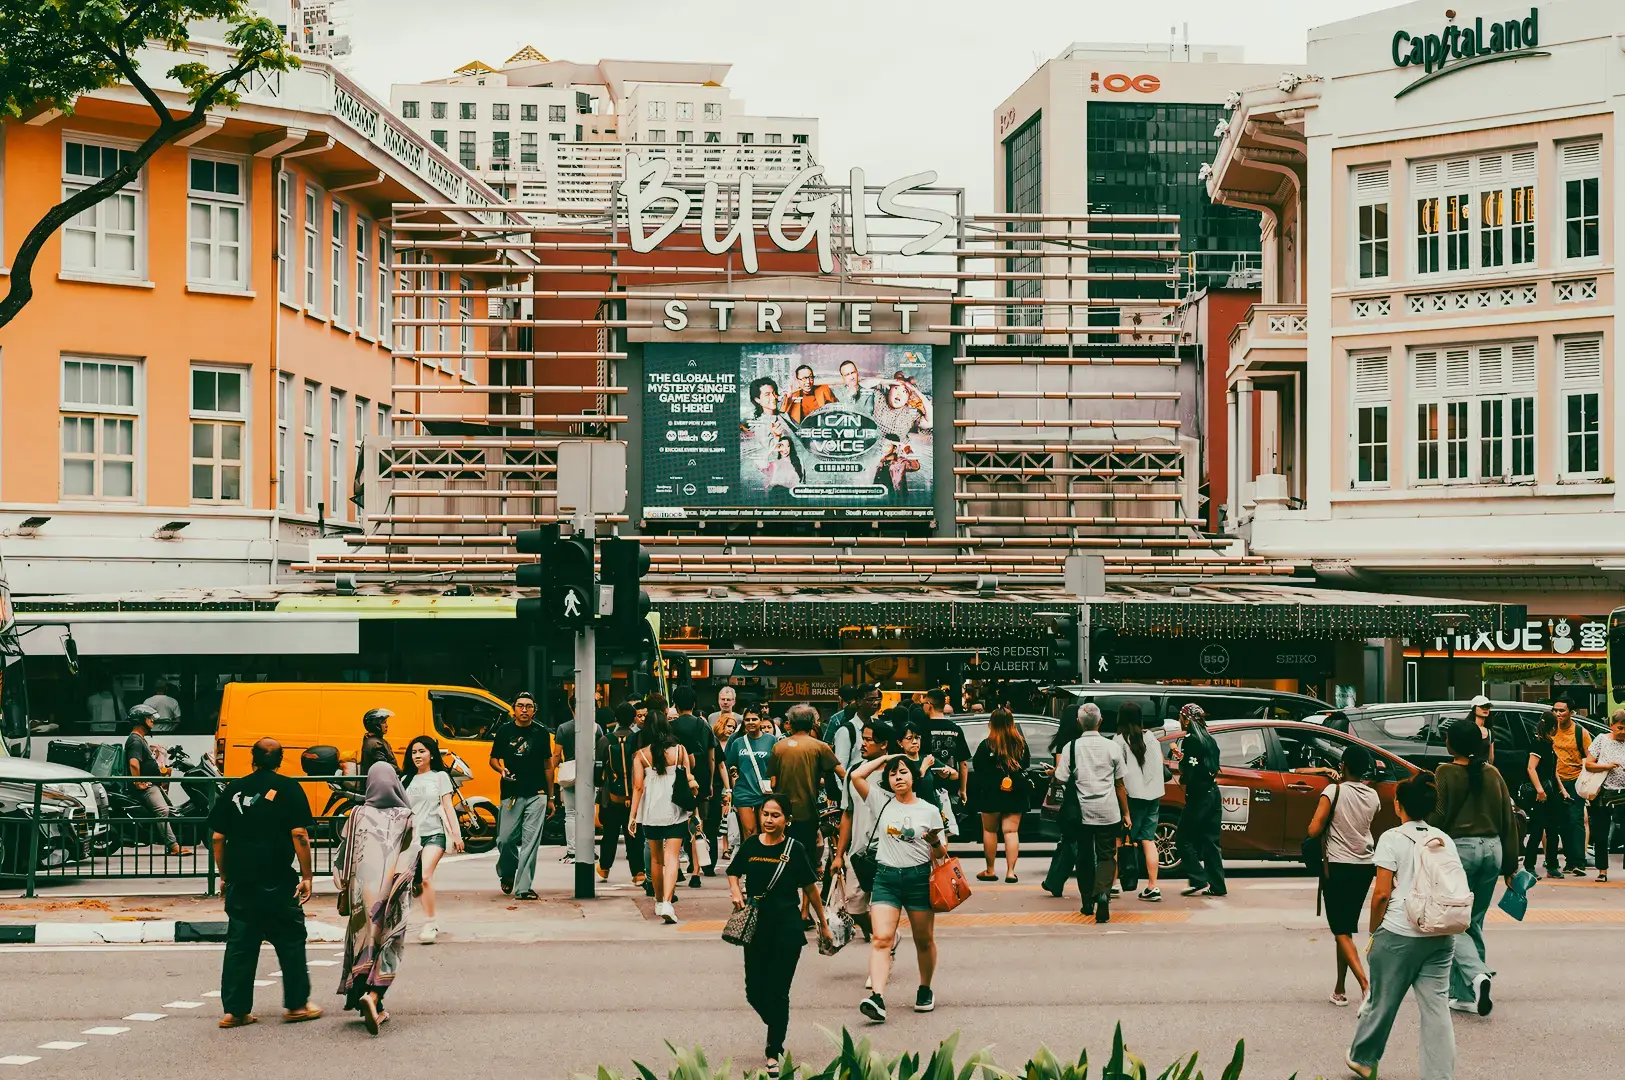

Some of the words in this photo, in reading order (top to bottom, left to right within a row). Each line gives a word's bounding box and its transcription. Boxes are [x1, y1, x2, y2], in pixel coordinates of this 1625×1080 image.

[1392, 7, 1538, 74] CapitaLand
[1103, 74, 1160, 93] OG
[618, 152, 955, 274] BUGIS
[663, 300, 919, 334] STREET
[649, 374, 671, 383] THE
[672, 374, 715, 383] GLOBAL
[716, 374, 735, 383] HIT
[647, 384, 695, 393] MYSTERY
[697, 384, 736, 393] SINGER
[659, 394, 690, 403] GAME
[691, 394, 725, 403] SHOW
[670, 404, 681, 413] IS
[682, 404, 714, 413] HERE!
[817, 415, 821, 427] I
[825, 415, 861, 427] CAN
[800, 428, 832, 439] SEE
[833, 428, 876, 439] YOUR
[814, 440, 864, 452] VOICE
[819, 464, 859, 472] SINGAPORE
[1204, 656, 1225, 664] BSO
[1276, 654, 1317, 664] SEIKO
[993, 662, 1035, 671] ALBERT
[1231, 824, 1247, 832] NOW
